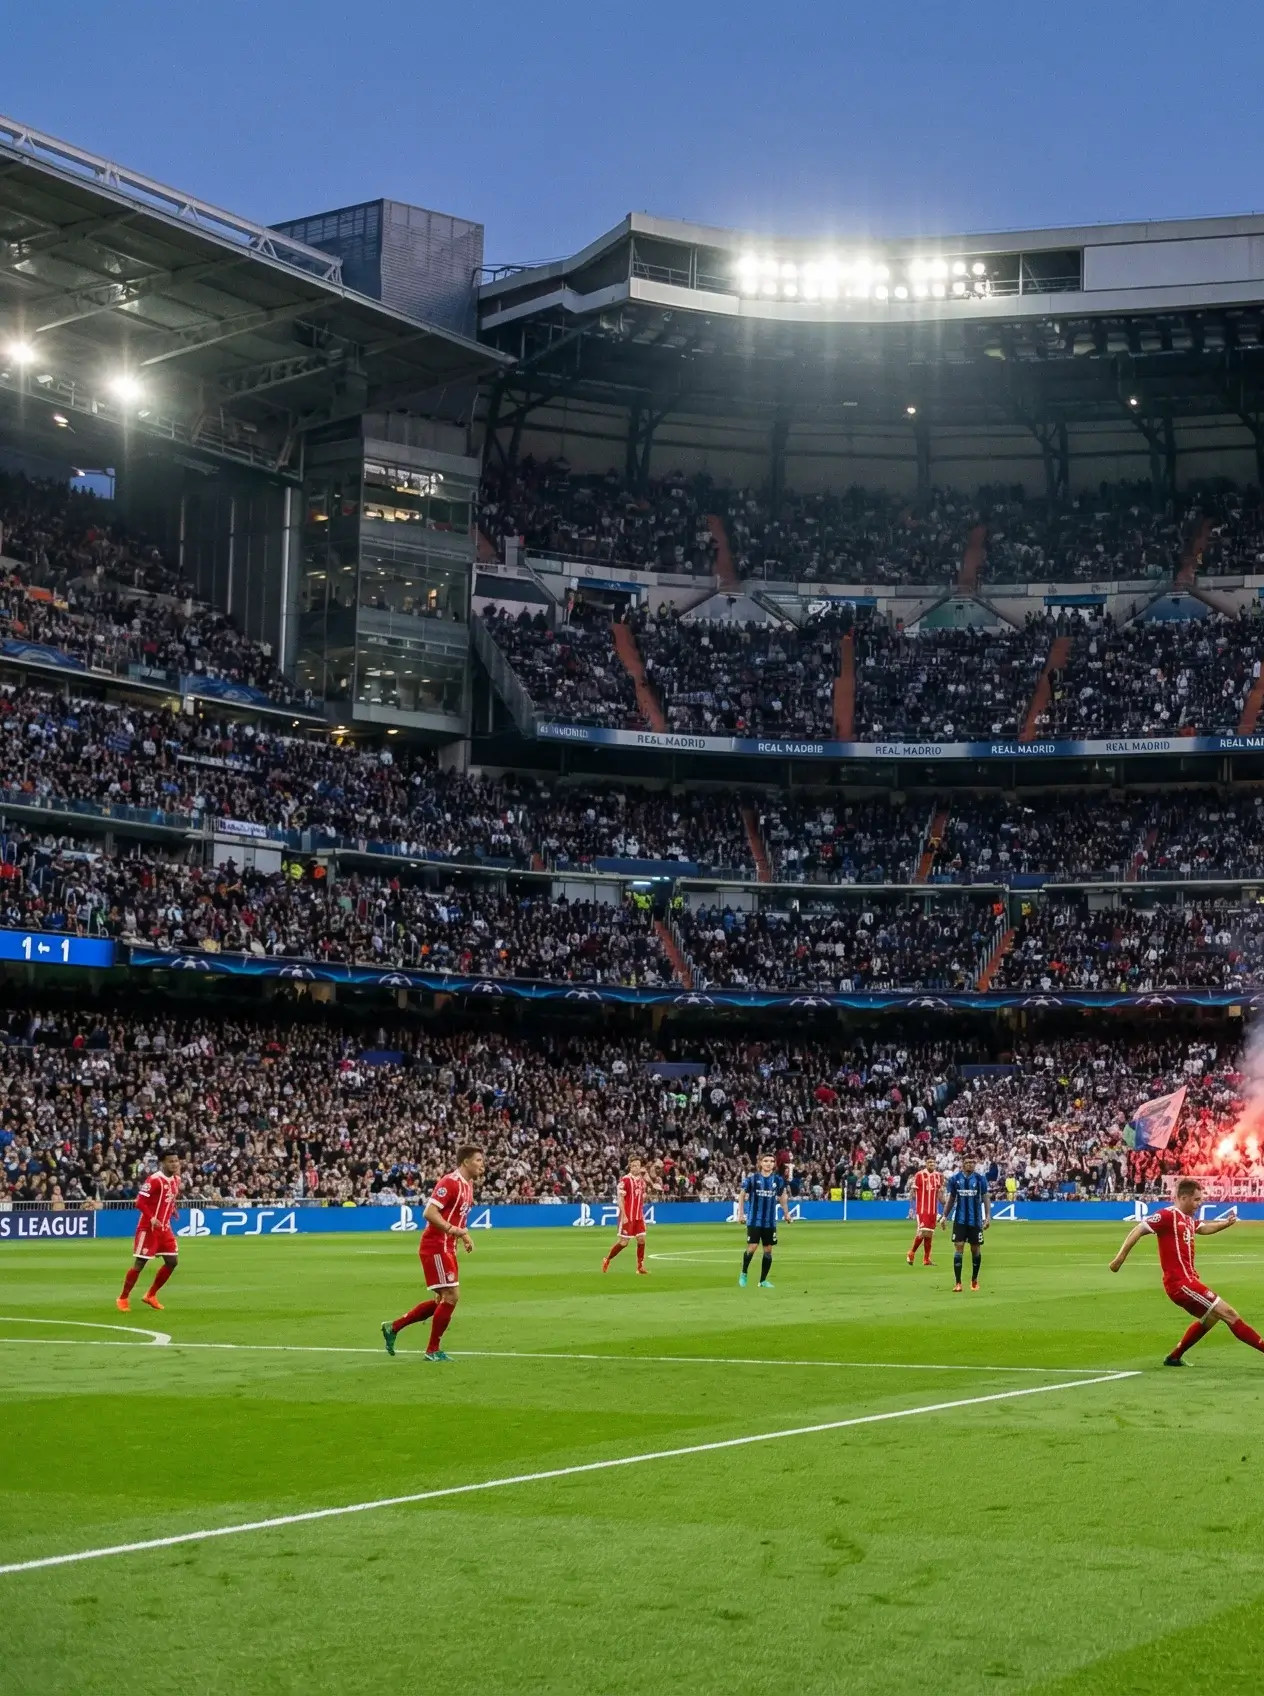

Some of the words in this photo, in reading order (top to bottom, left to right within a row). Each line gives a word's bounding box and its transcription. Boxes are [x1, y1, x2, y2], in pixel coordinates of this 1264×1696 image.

[665, 736, 706, 748] MADRID
[1106, 742, 1129, 752] REAL
[875, 746, 900, 755] REAL
[991, 745, 1016, 754] REAL
[1017, 744, 1055, 753] MADRID
[22, 936, 31, 960] 1
[61, 939, 70, 962] 1
[18, 1216, 88, 1236] LEAGUE
[221, 1211, 298, 1236] PS4
